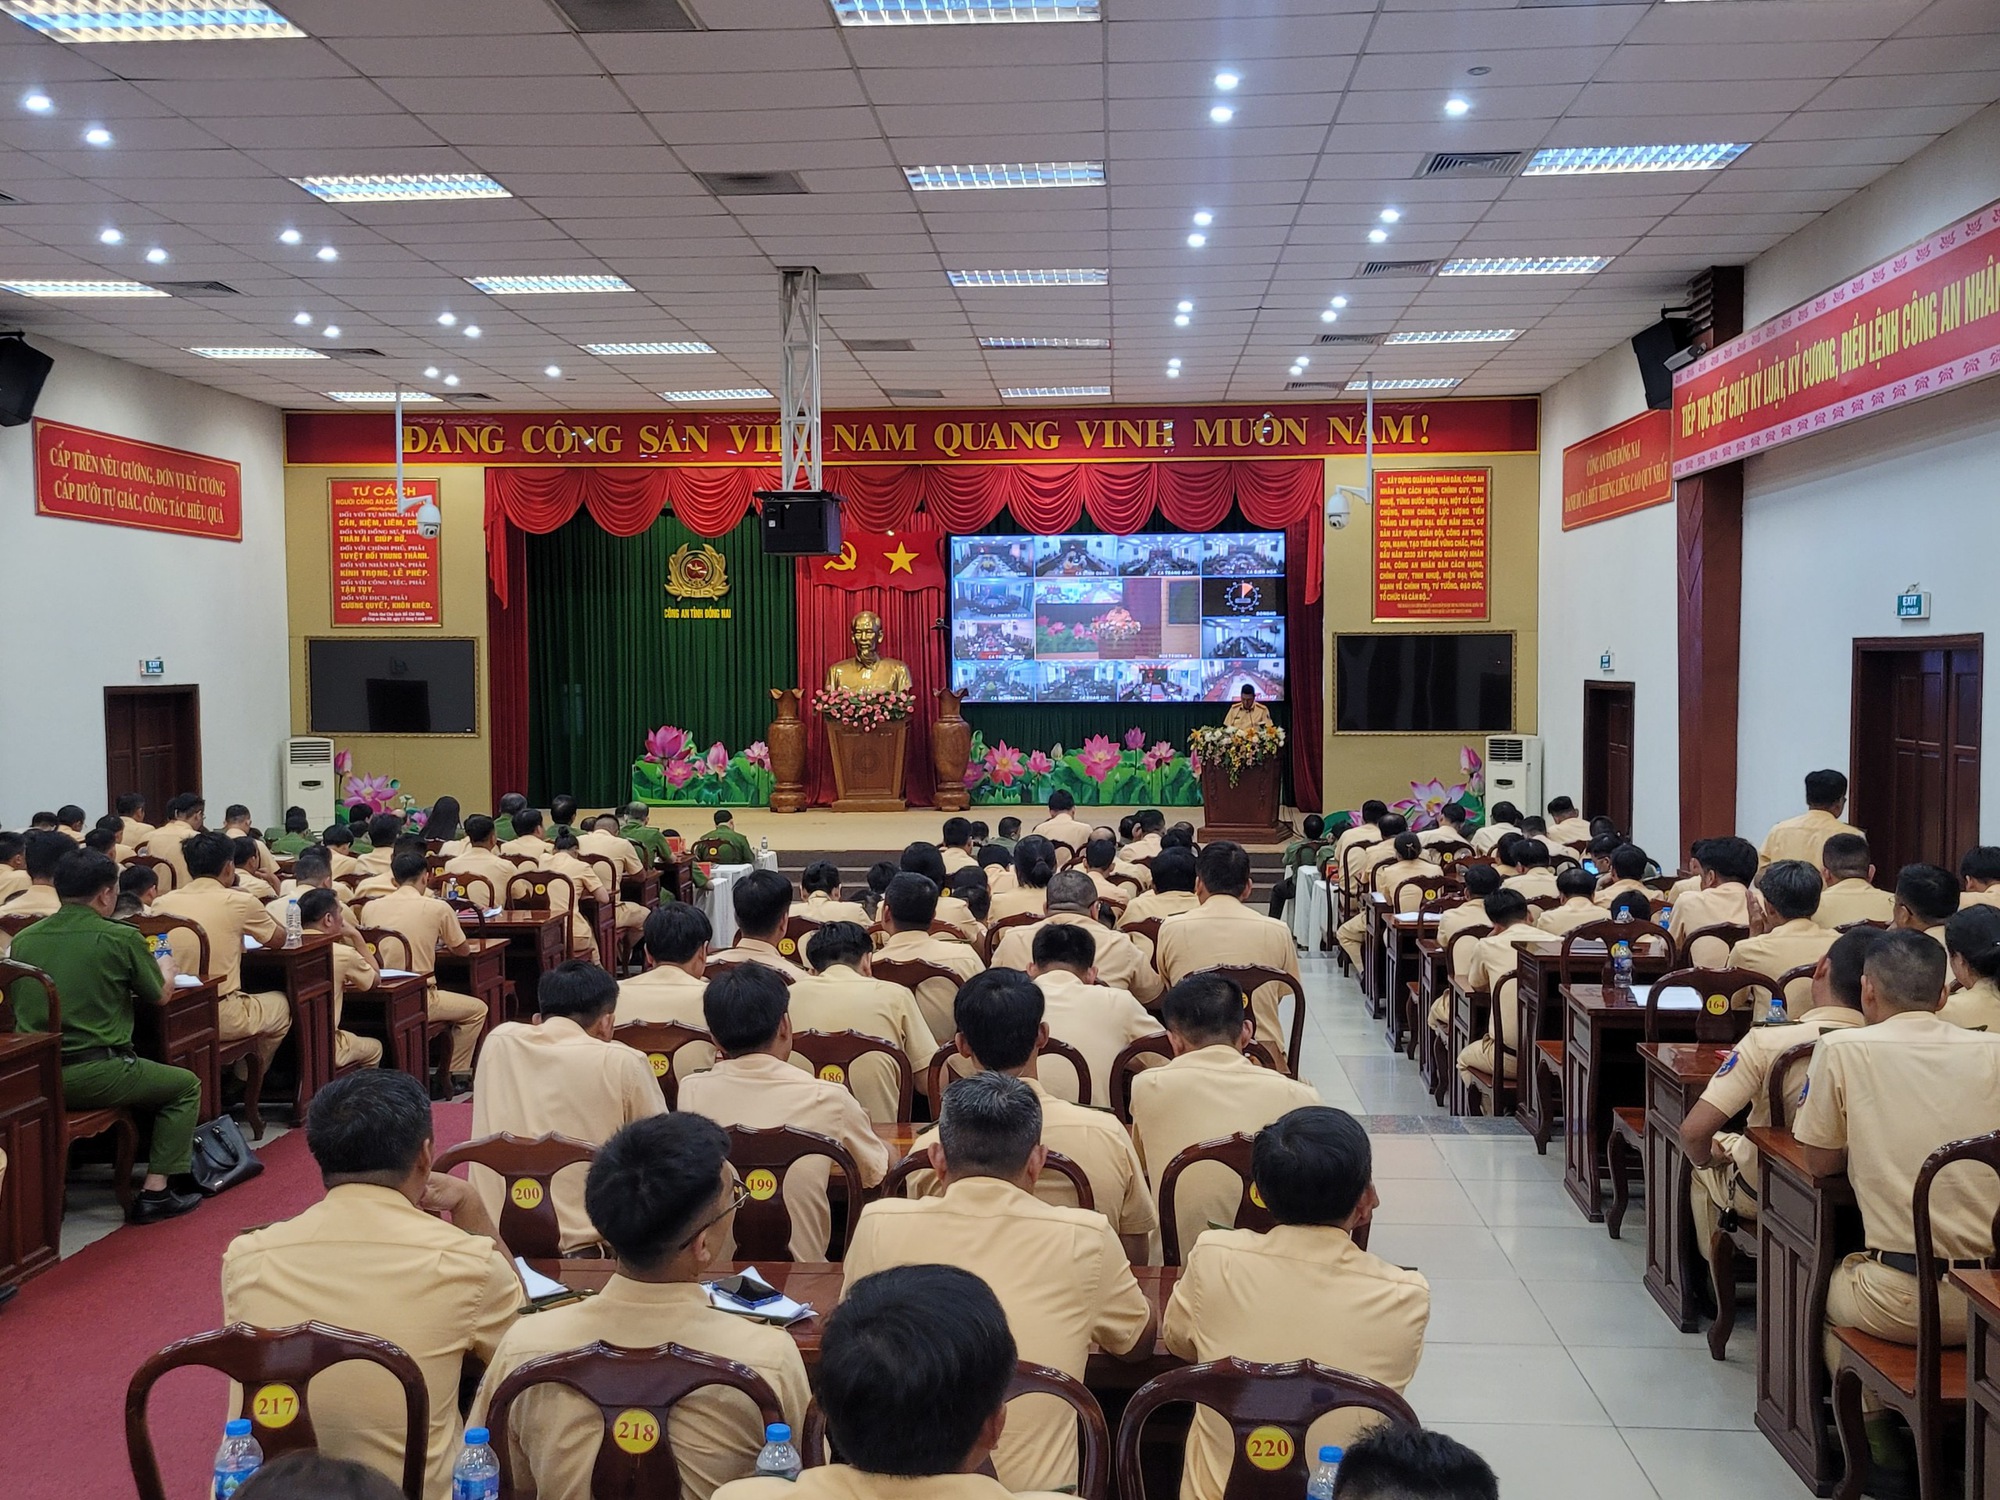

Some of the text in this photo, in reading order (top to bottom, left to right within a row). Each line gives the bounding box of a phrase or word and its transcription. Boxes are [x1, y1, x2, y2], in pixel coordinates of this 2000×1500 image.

[1682, 392, 1696, 438] TIẾP
[1697, 394, 1710, 438] TỤC
[1711, 376, 1728, 426] SIẾT
[1728, 371, 1749, 423] CHẶT
[1751, 359, 1762, 410] KỶ
[1763, 355, 1786, 409] LUẬT,
[1788, 341, 1800, 395] KỶ
[1802, 337, 1839, 389] CƯƠNG,
[1841, 312, 1867, 374] ĐIỀU
[1868, 307, 1899, 370] LỆNH
[1902, 290, 1937, 349] CÔNG
[1940, 280, 1961, 334] AN
[402, 418, 505, 454] ĐẢNG
[521, 419, 623, 459] CỘNG
[638, 418, 710, 454] SẢN
[832, 423, 917, 452] NAM
[933, 420, 1062, 457] QUANG
[1075, 419, 1175, 449] VINH
[1193, 411, 1309, 448] MUÔN
[50, 440, 226, 498] CẤP TRÊN NÊU GƯƠNG, ĐƠN VỊ KỶ CƯƠNG
[352, 485, 370, 496] TƯ
[54, 473, 225, 526] CẤP DƯỚI TỰ GIÁC, CÔNG TÁC HIỆU QUẢ
[780, 943, 794, 951] 153
[1708, 1000, 1725, 1009] 164
[650, 1060, 666, 1070] 85
[823, 1072, 841, 1082] 186
[750, 1178, 773, 1191] 199
[515, 1187, 540, 1200] 200
[258, 1397, 294, 1415] 217
[618, 1421, 654, 1442] 218
[1252, 1438, 1289, 1457] 220
